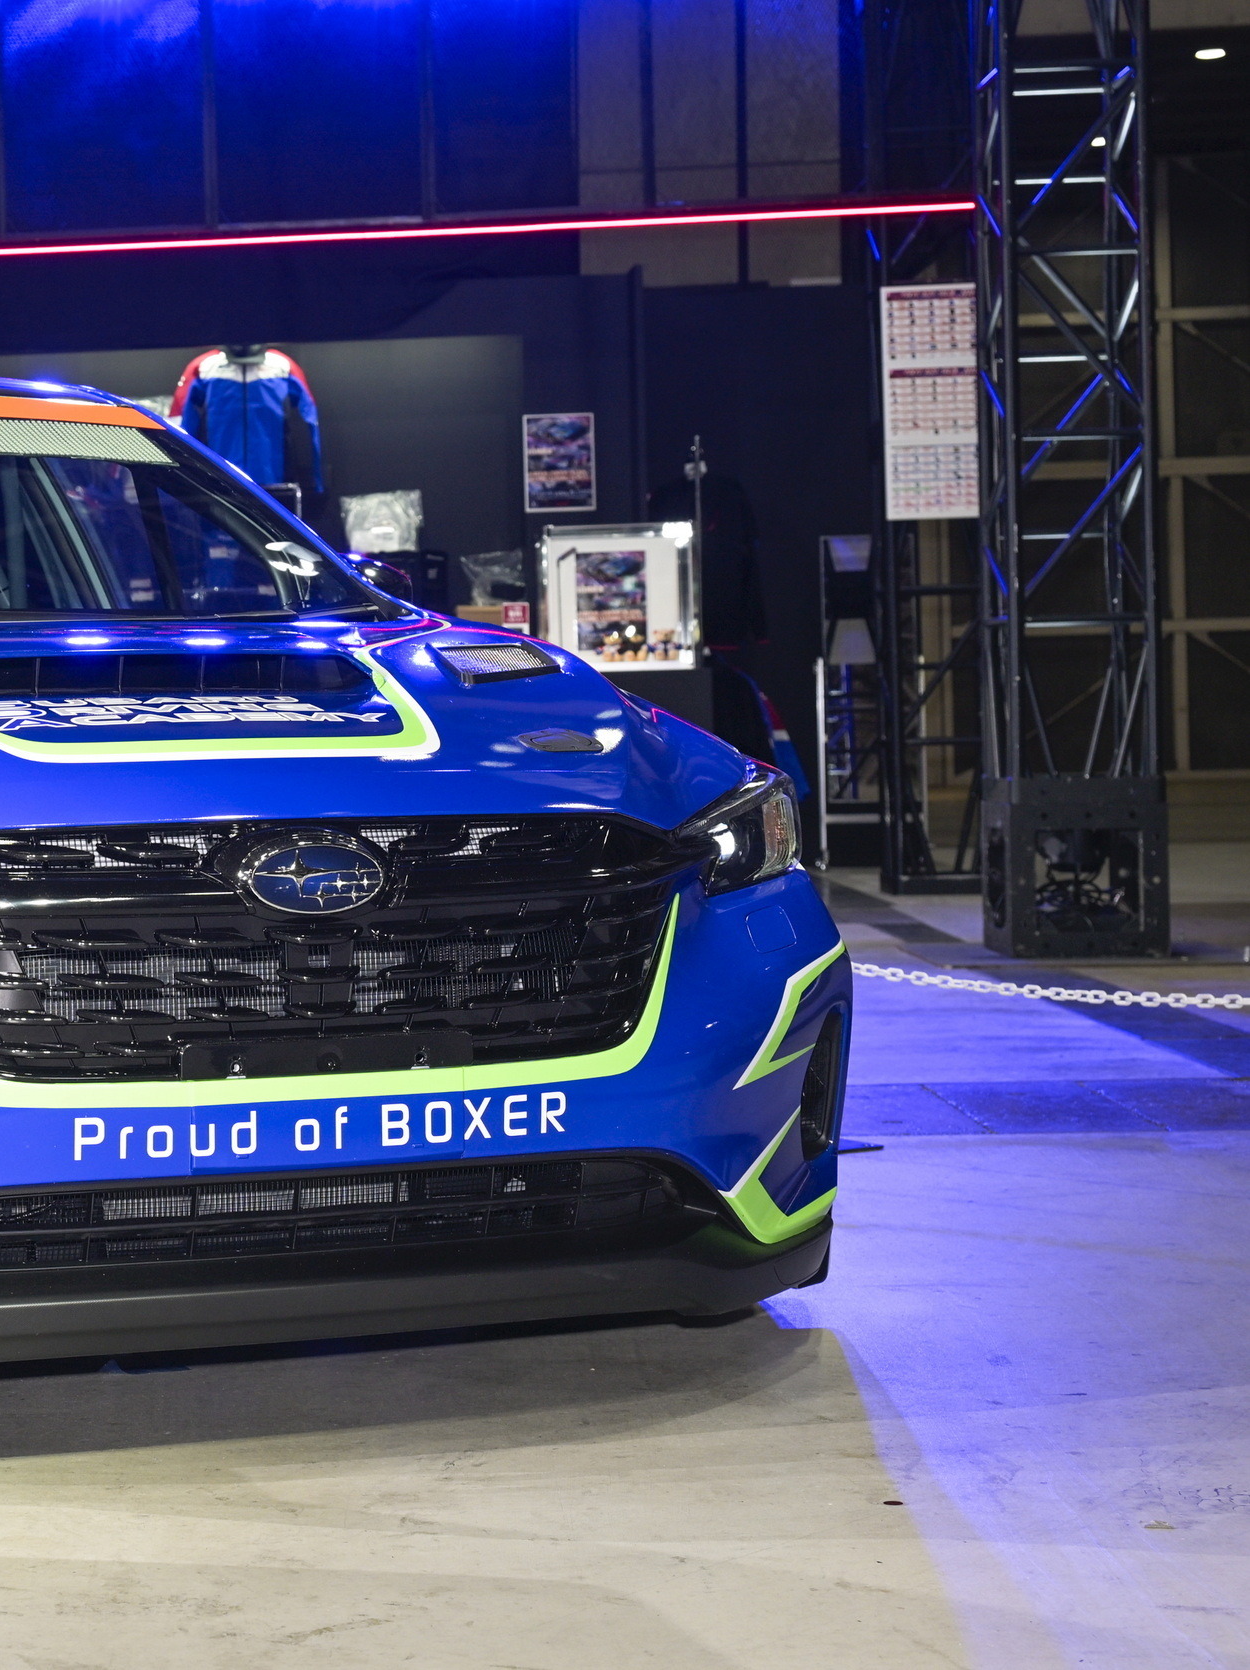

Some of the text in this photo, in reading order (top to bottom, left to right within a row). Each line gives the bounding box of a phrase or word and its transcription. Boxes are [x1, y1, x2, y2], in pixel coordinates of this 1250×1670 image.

[74, 1091, 567, 1161] Proud of BOXER
